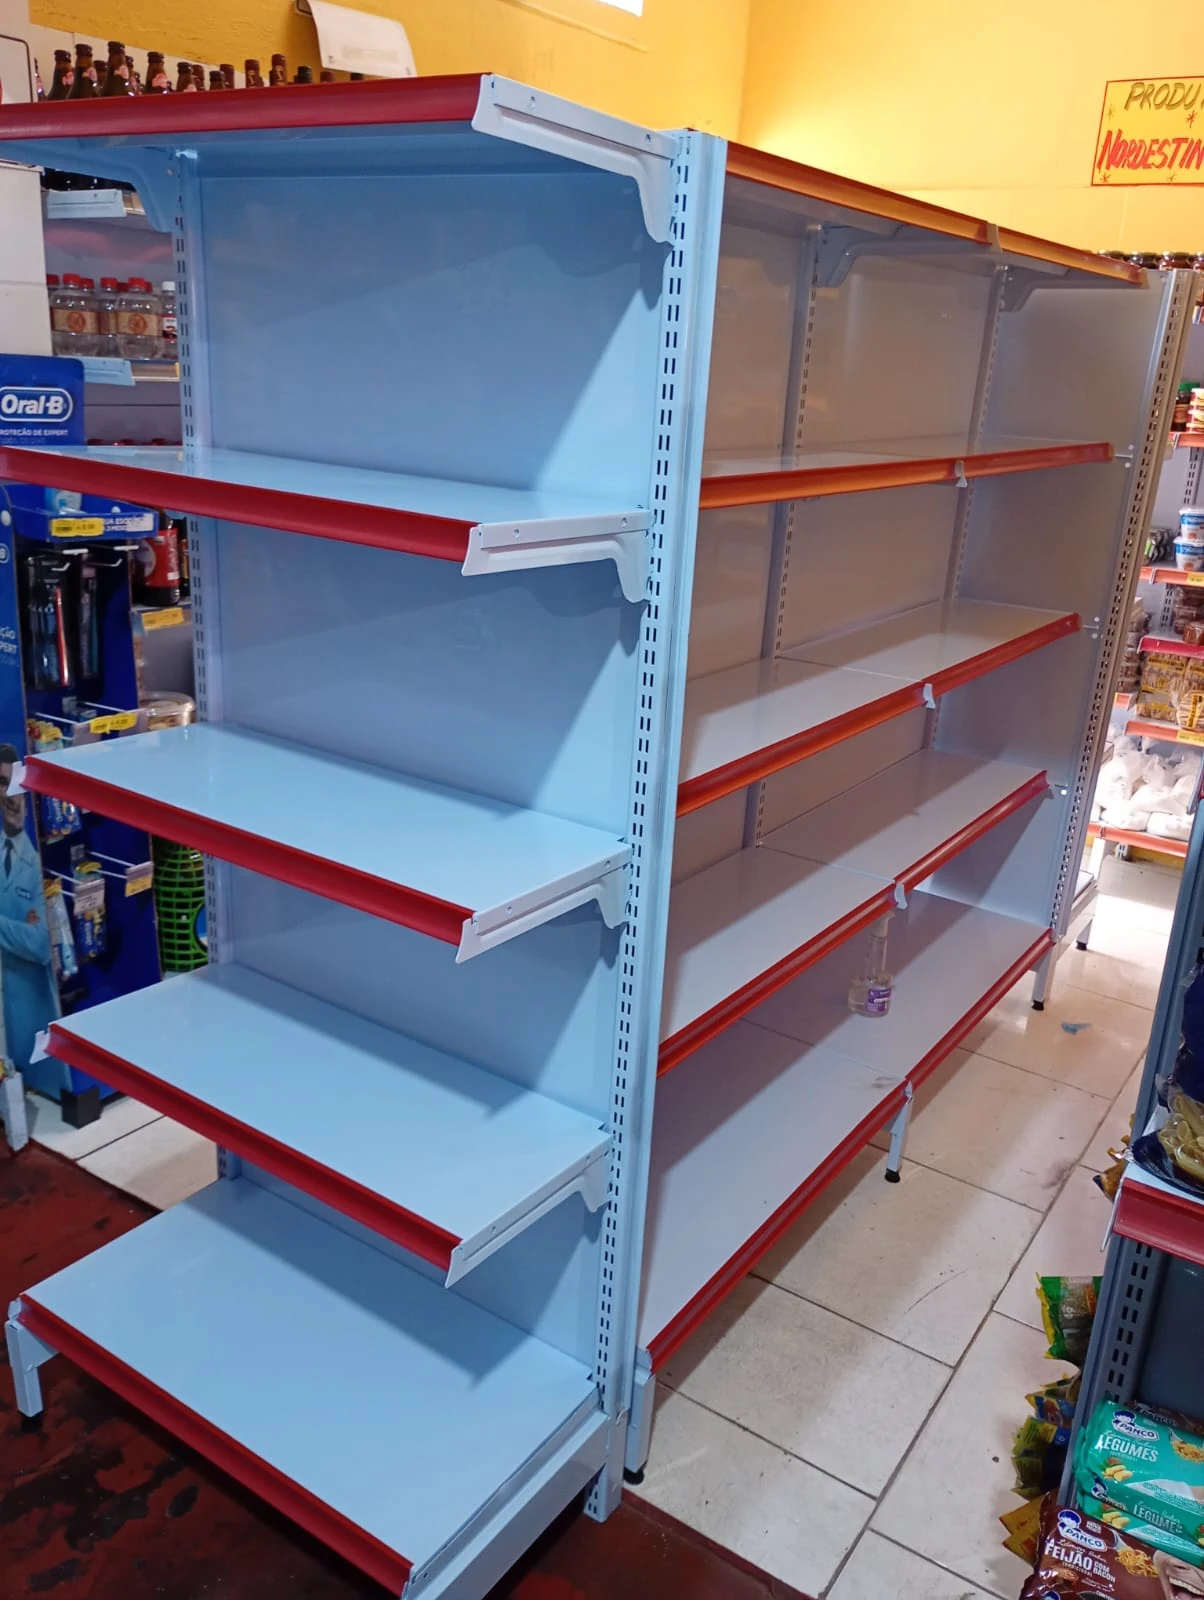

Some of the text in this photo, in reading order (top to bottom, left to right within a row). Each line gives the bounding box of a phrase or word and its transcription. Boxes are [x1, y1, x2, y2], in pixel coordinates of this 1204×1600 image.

[1, 394, 64, 415] Oral-B
[1119, 1421, 1155, 1438] PANCO
[1133, 1504, 1183, 1534] LEGUMES
[1065, 1528, 1103, 1548] PANCO
[1044, 1542, 1093, 1572] FEIJÃO
